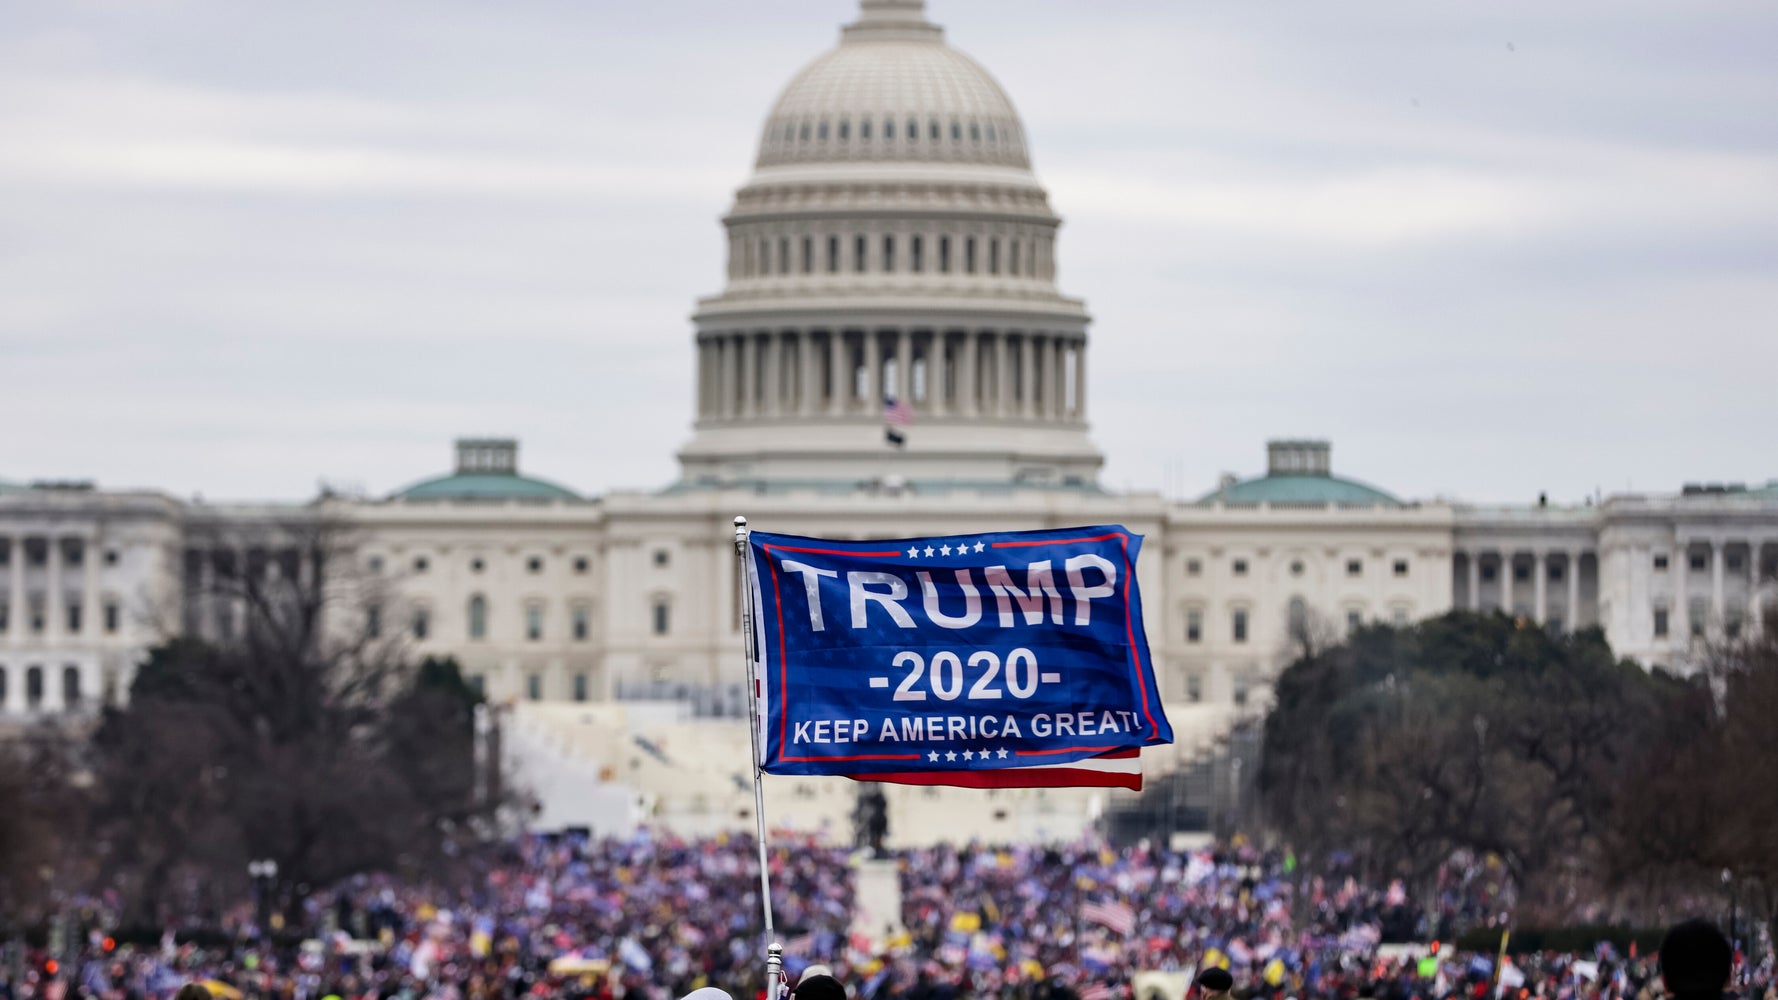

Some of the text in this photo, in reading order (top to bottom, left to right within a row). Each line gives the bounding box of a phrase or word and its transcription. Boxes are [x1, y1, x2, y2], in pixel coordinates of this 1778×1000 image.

[781, 554, 1117, 632] TRUMP
[869, 647, 1061, 701] -2020-
[793, 710, 1142, 744] KEEP AMERICA GREAT!
